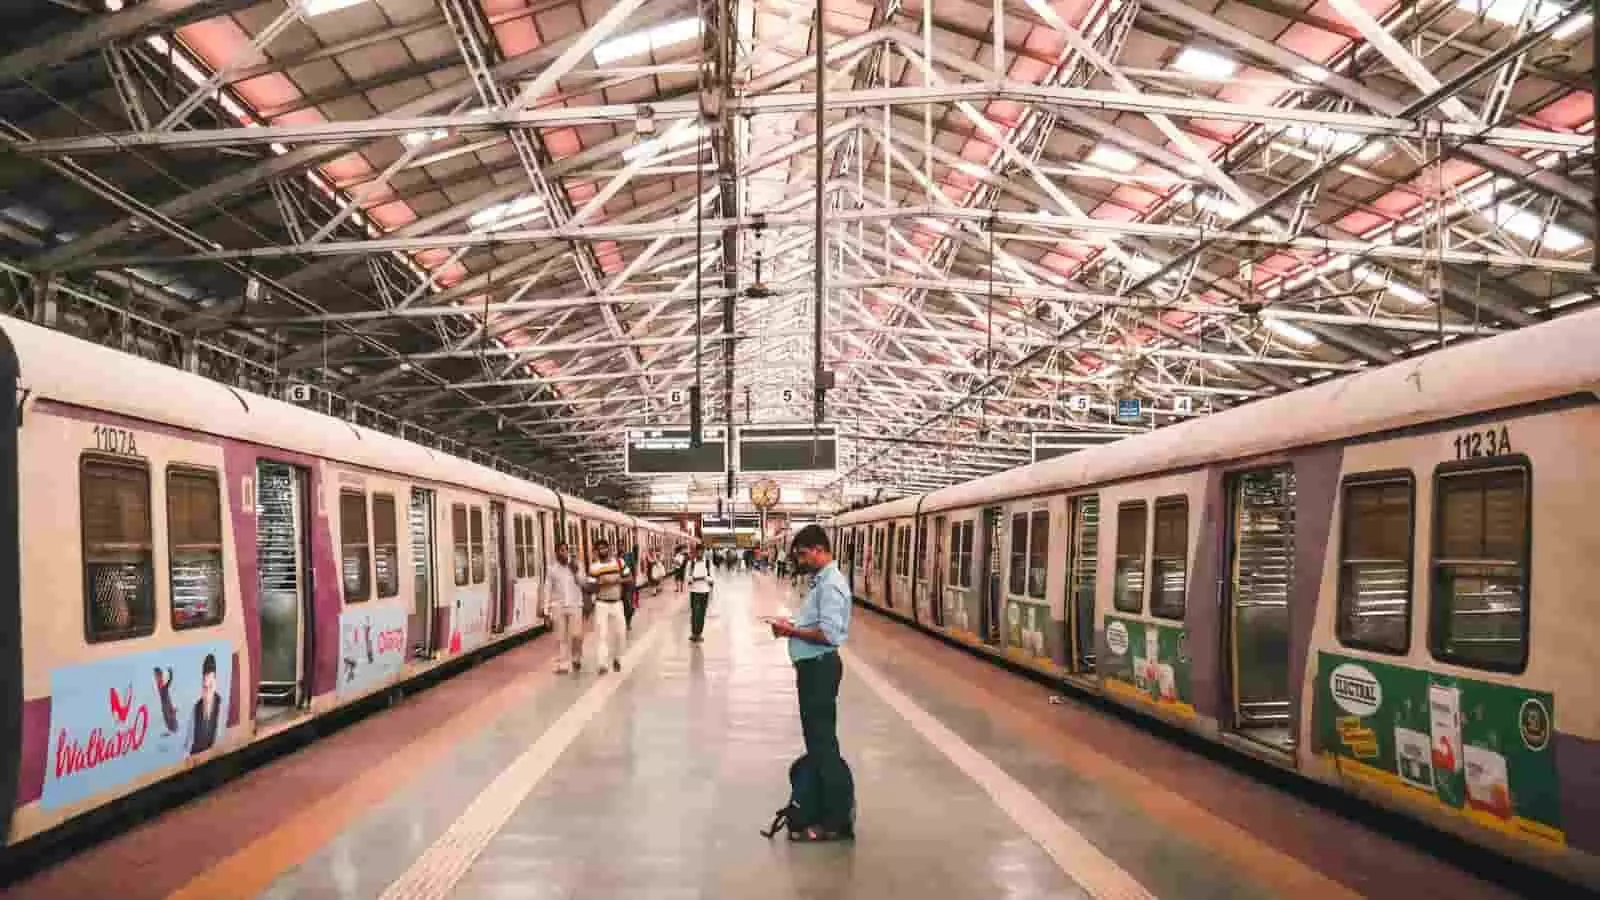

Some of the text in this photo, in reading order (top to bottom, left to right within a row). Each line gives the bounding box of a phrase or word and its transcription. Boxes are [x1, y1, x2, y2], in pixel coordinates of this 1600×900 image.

[295, 387, 304, 400] 6
[671, 391, 681, 402] 6
[783, 389, 793, 402] 5
